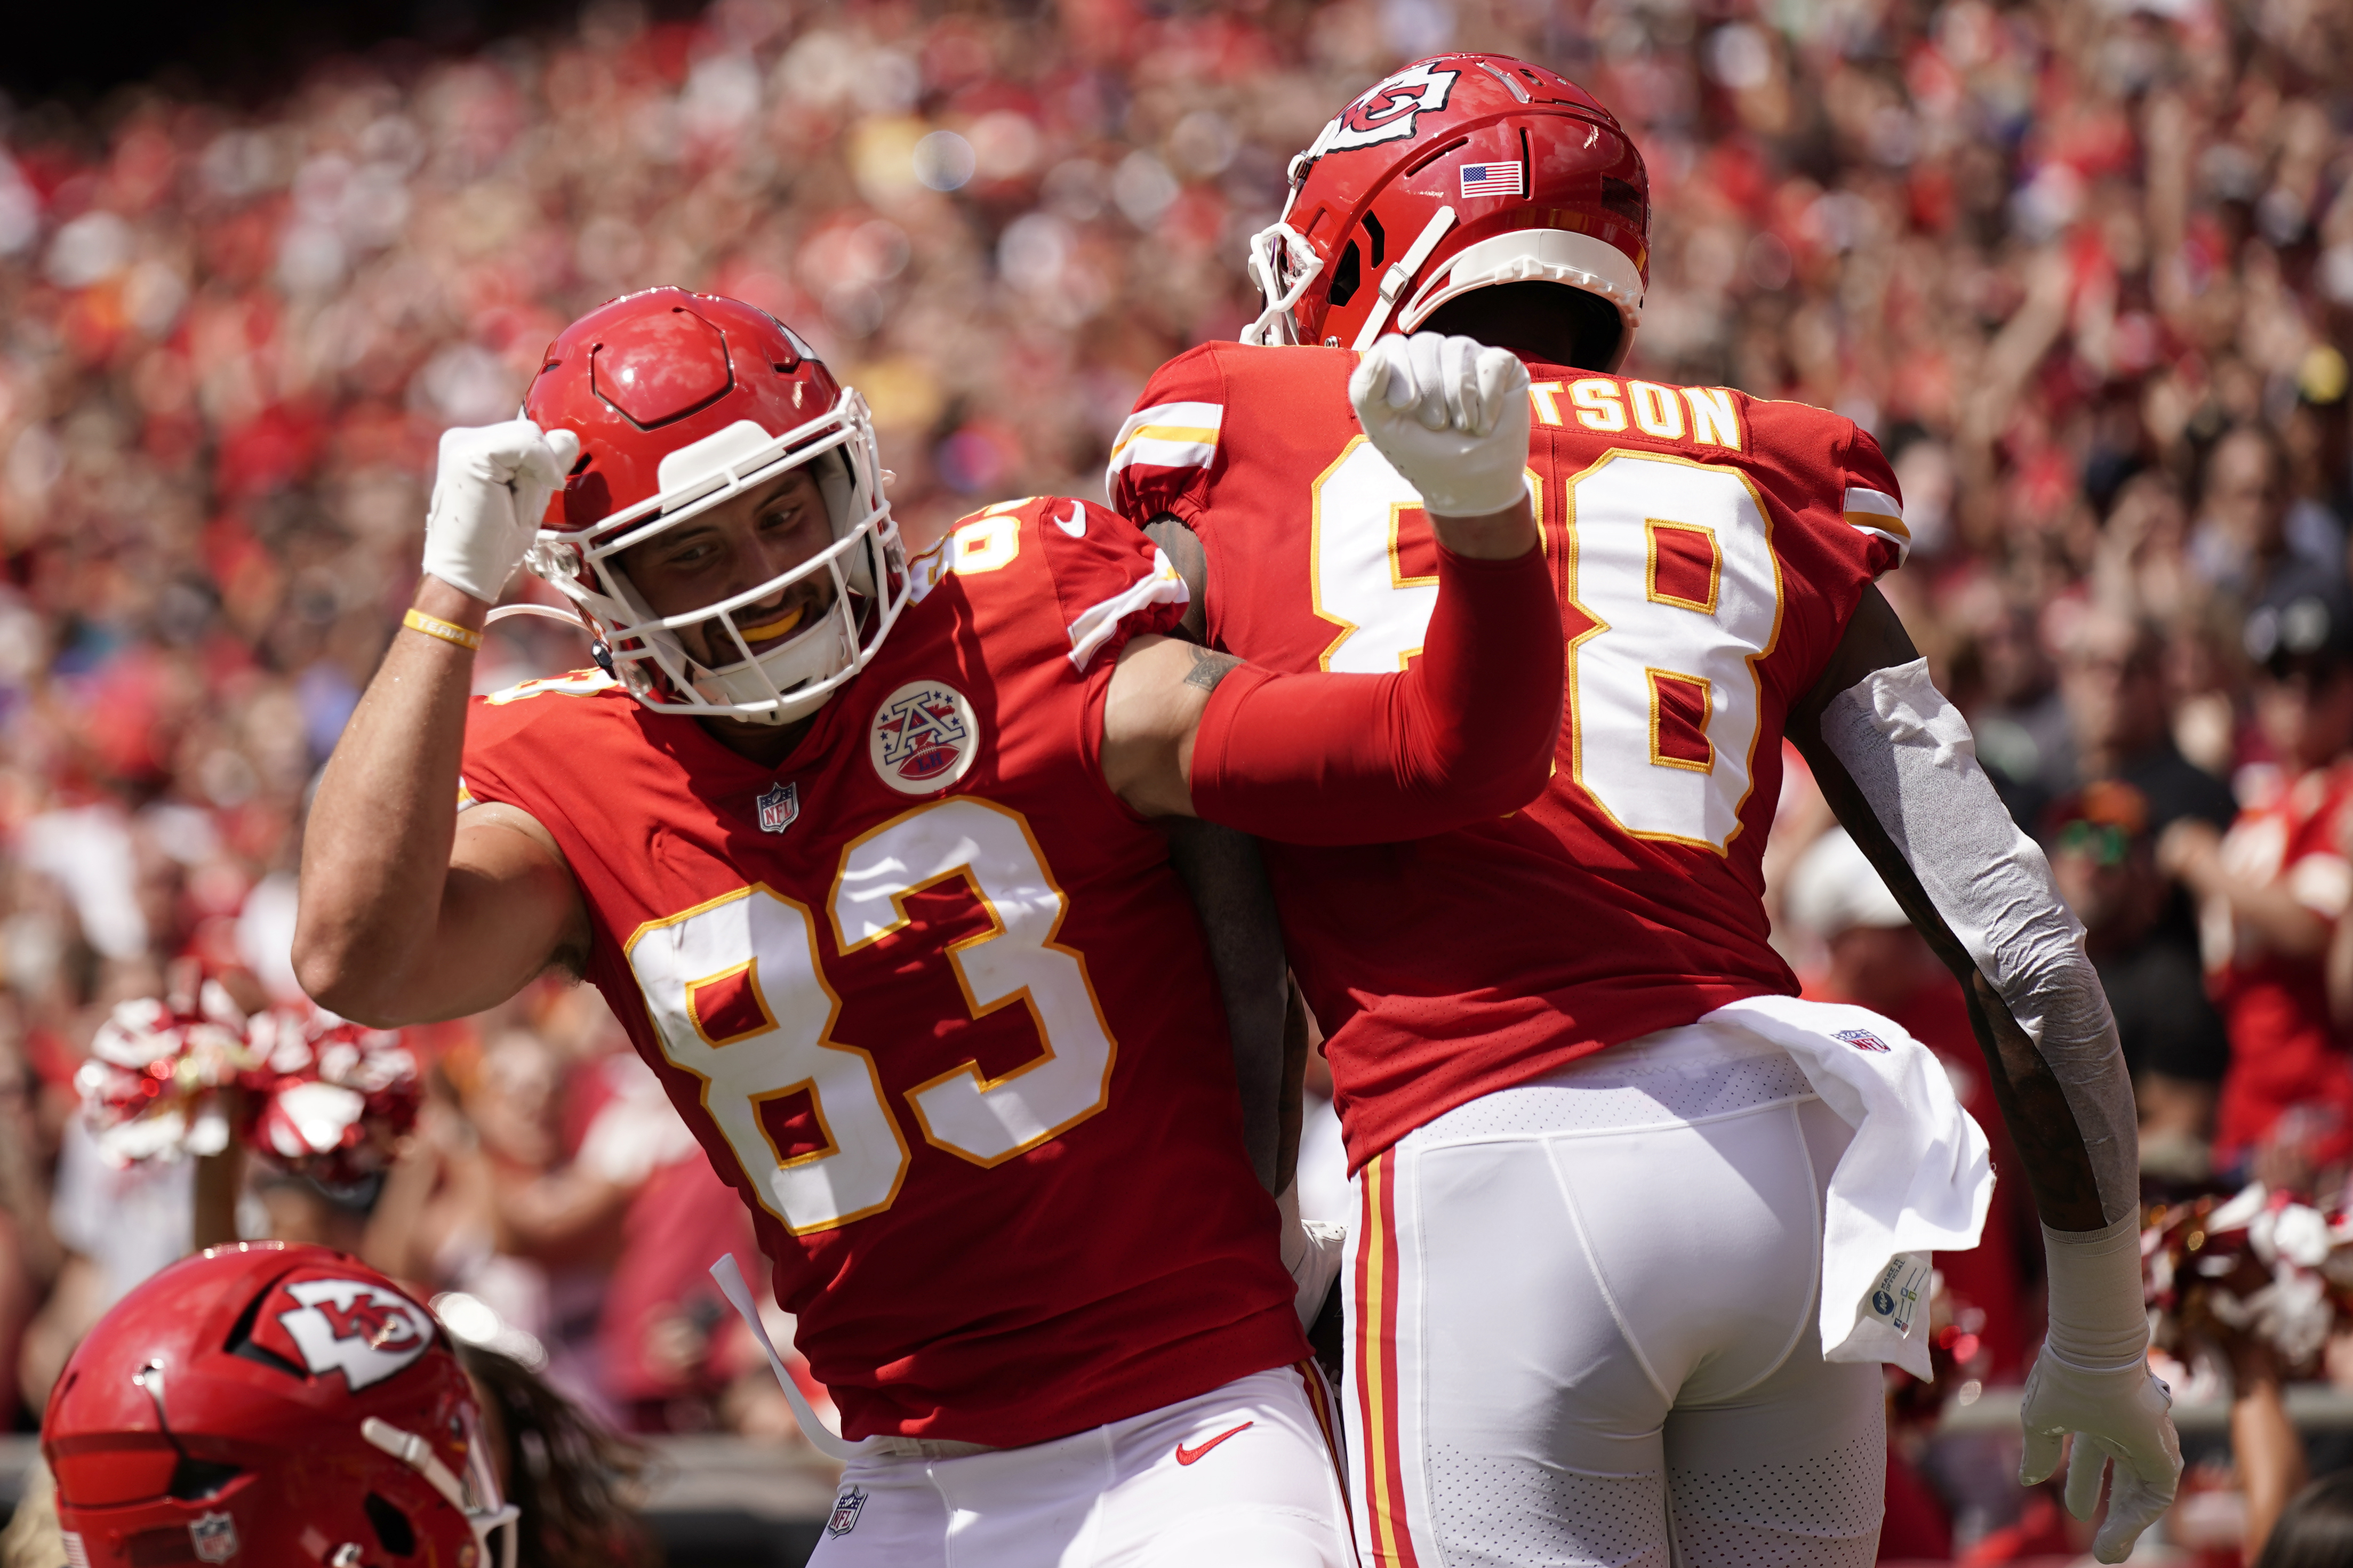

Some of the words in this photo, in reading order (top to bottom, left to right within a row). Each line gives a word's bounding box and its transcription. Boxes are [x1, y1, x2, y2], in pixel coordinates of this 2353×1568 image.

[418, 617, 466, 641] TEAM
[916, 751, 943, 772] LH
[765, 801, 793, 825] NFL
[623, 795, 1118, 1237] 83
[1847, 1039, 1888, 1051] NFL
[1881, 1266, 1895, 1290] MAKE
[1885, 1261, 1906, 1292] OFFICIAL
[831, 1510, 852, 1529] NFL
